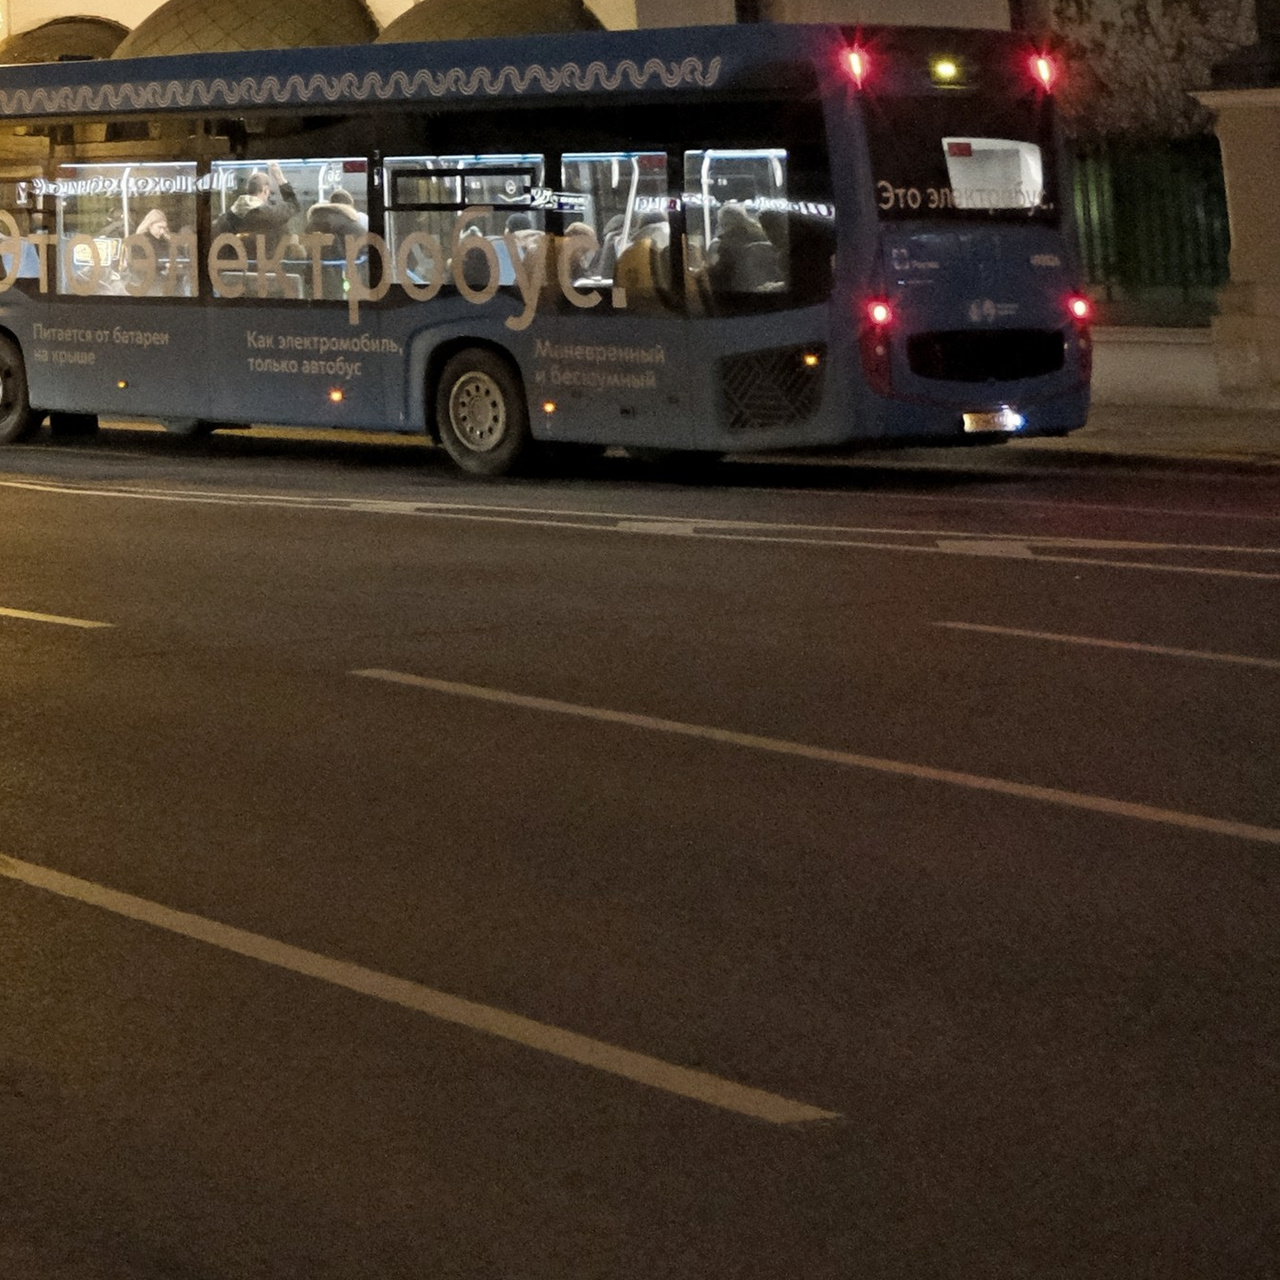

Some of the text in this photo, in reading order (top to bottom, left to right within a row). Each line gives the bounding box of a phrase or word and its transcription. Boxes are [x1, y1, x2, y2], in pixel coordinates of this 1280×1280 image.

[877, 180, 922, 210] Это
[121, 206, 628, 330] электробус.
[32, 323, 169, 348] Питается от батареи
[246, 330, 403, 356] Как электромобиль,
[33, 348, 96, 365] на крыше
[247, 356, 362, 380] только автобус
